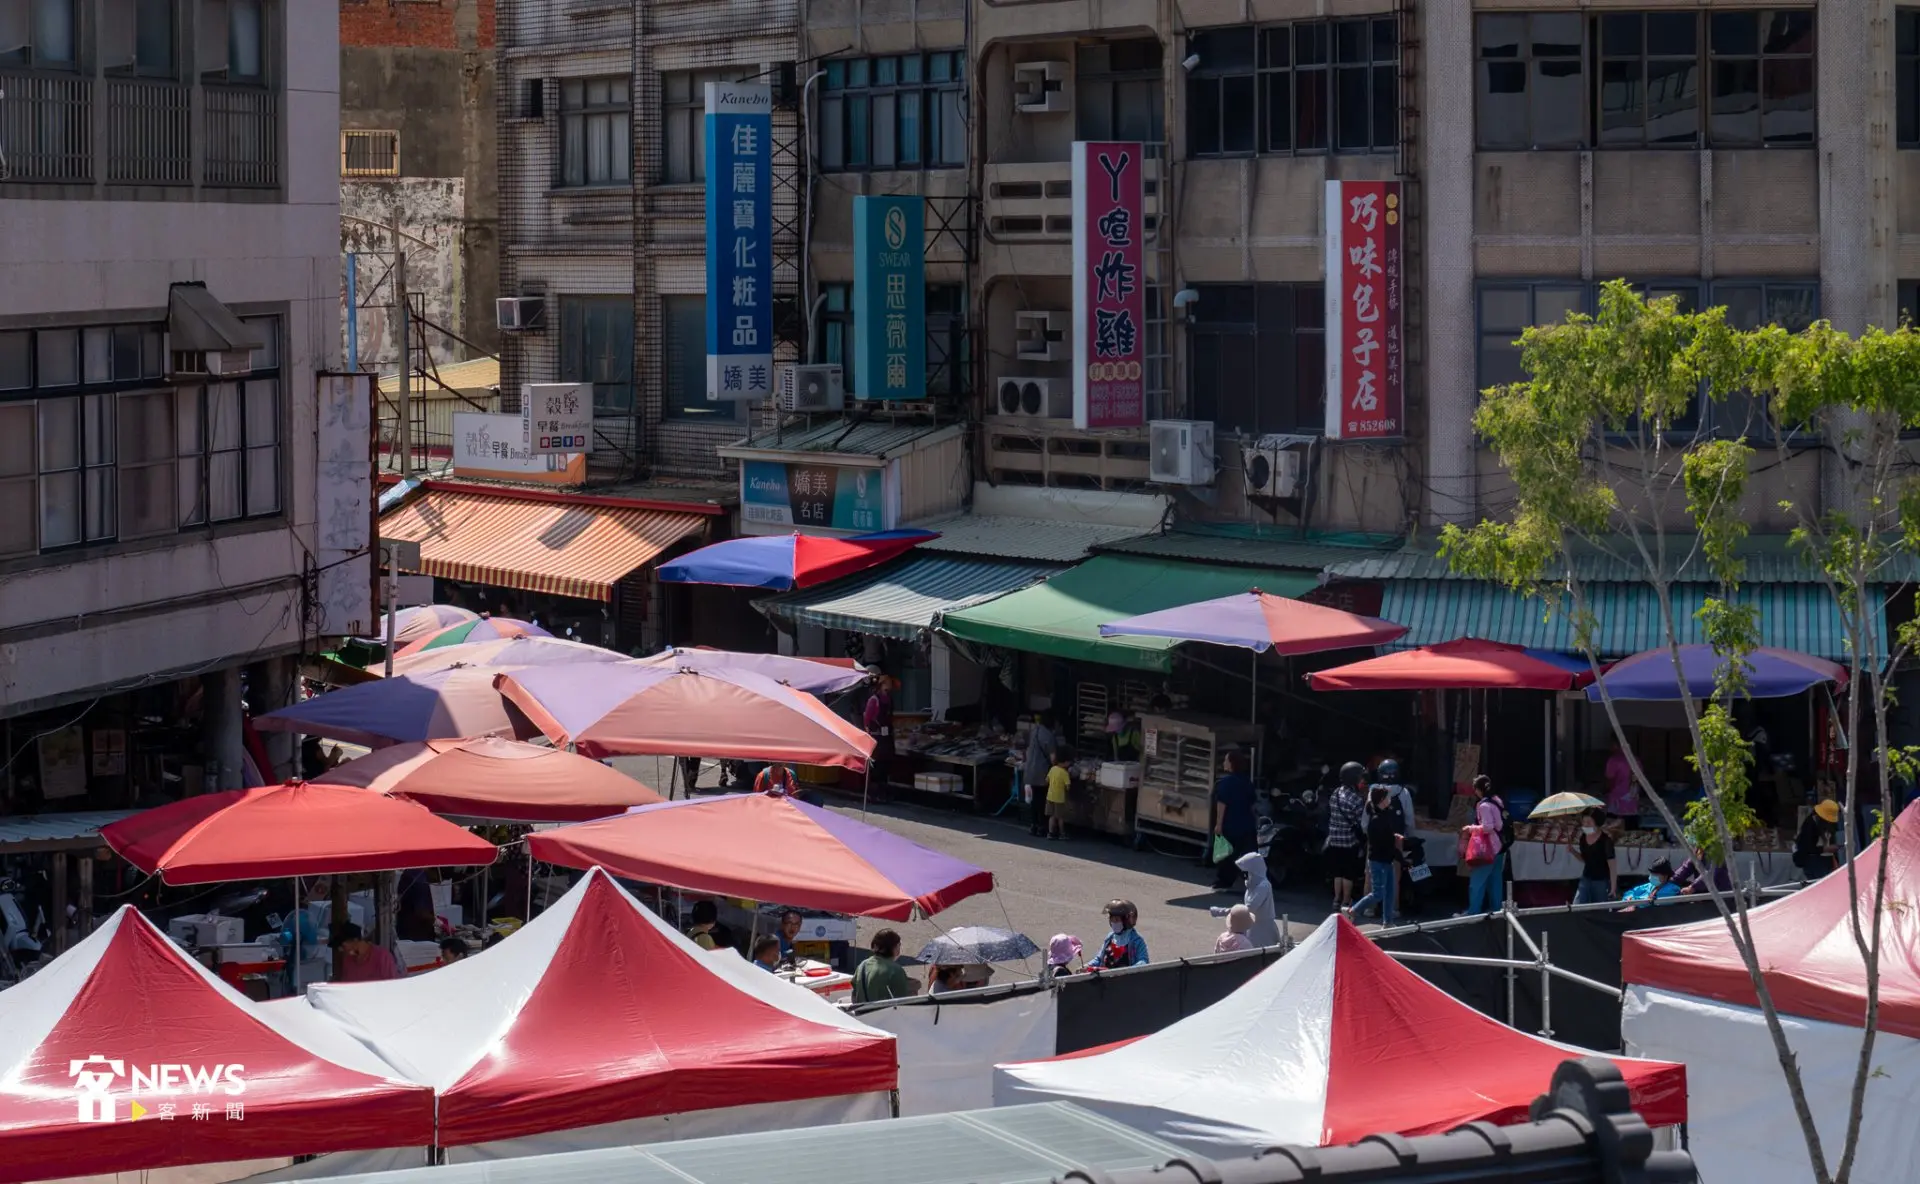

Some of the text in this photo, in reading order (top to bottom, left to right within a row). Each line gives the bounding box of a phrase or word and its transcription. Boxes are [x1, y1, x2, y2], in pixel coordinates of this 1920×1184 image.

[720, 92, 769, 105] Kanebo
[731, 123, 758, 347] 佳麗寶化粧品
[878, 252, 912, 268] SWEAR
[1349, 193, 1382, 411] 巧味包子店
[886, 273, 907, 389] 思薇爾
[724, 365, 767, 391] 嬌美
[537, 421, 559, 433] 早餐
[1360, 418, 1396, 432] 852608
[492, 441, 509, 459] 早餐
[749, 476, 781, 492] Kanebo
[794, 469, 828, 497] 嬌美
[800, 500, 824, 520] 名店
